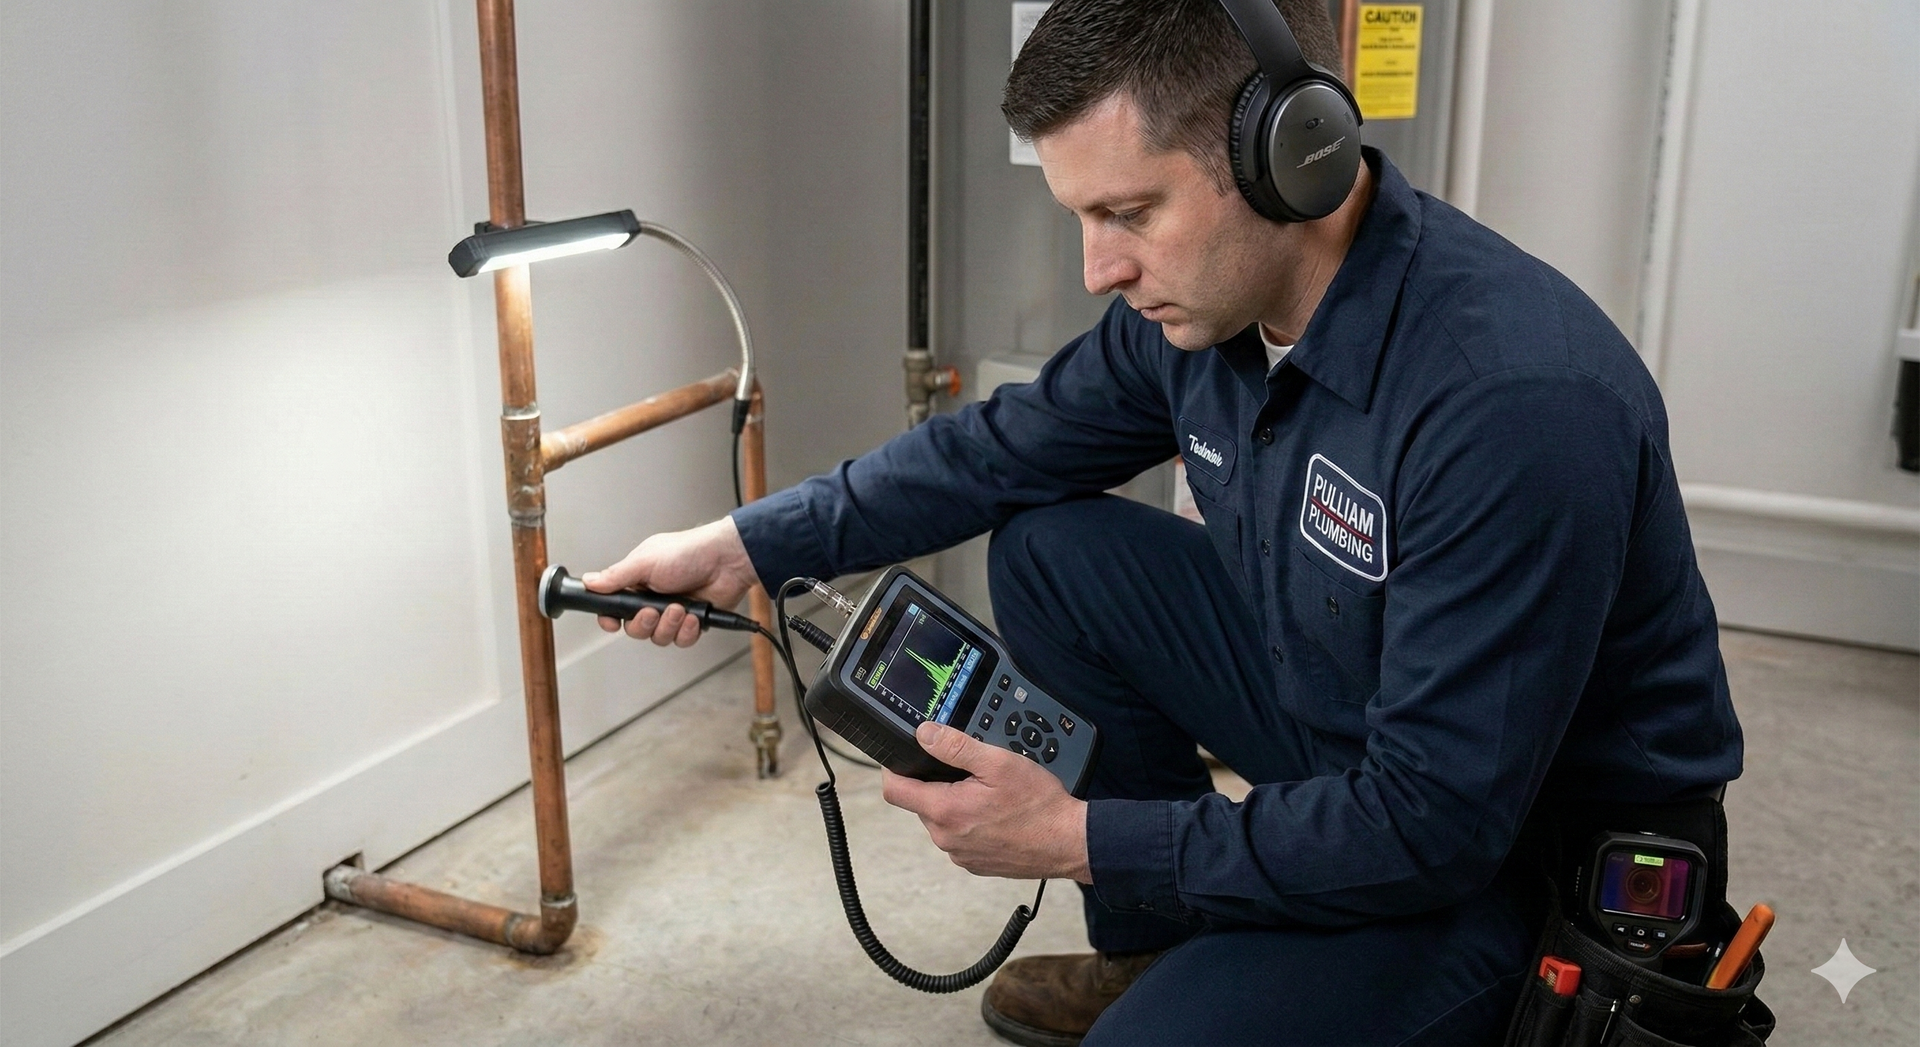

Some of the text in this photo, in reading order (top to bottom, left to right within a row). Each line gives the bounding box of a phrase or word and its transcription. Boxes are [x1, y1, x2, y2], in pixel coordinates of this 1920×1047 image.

[1297, 137, 1346, 168] BOSE
[1308, 503, 1373, 564] PLUMBING
[1313, 473, 1374, 537] PULLIAM
